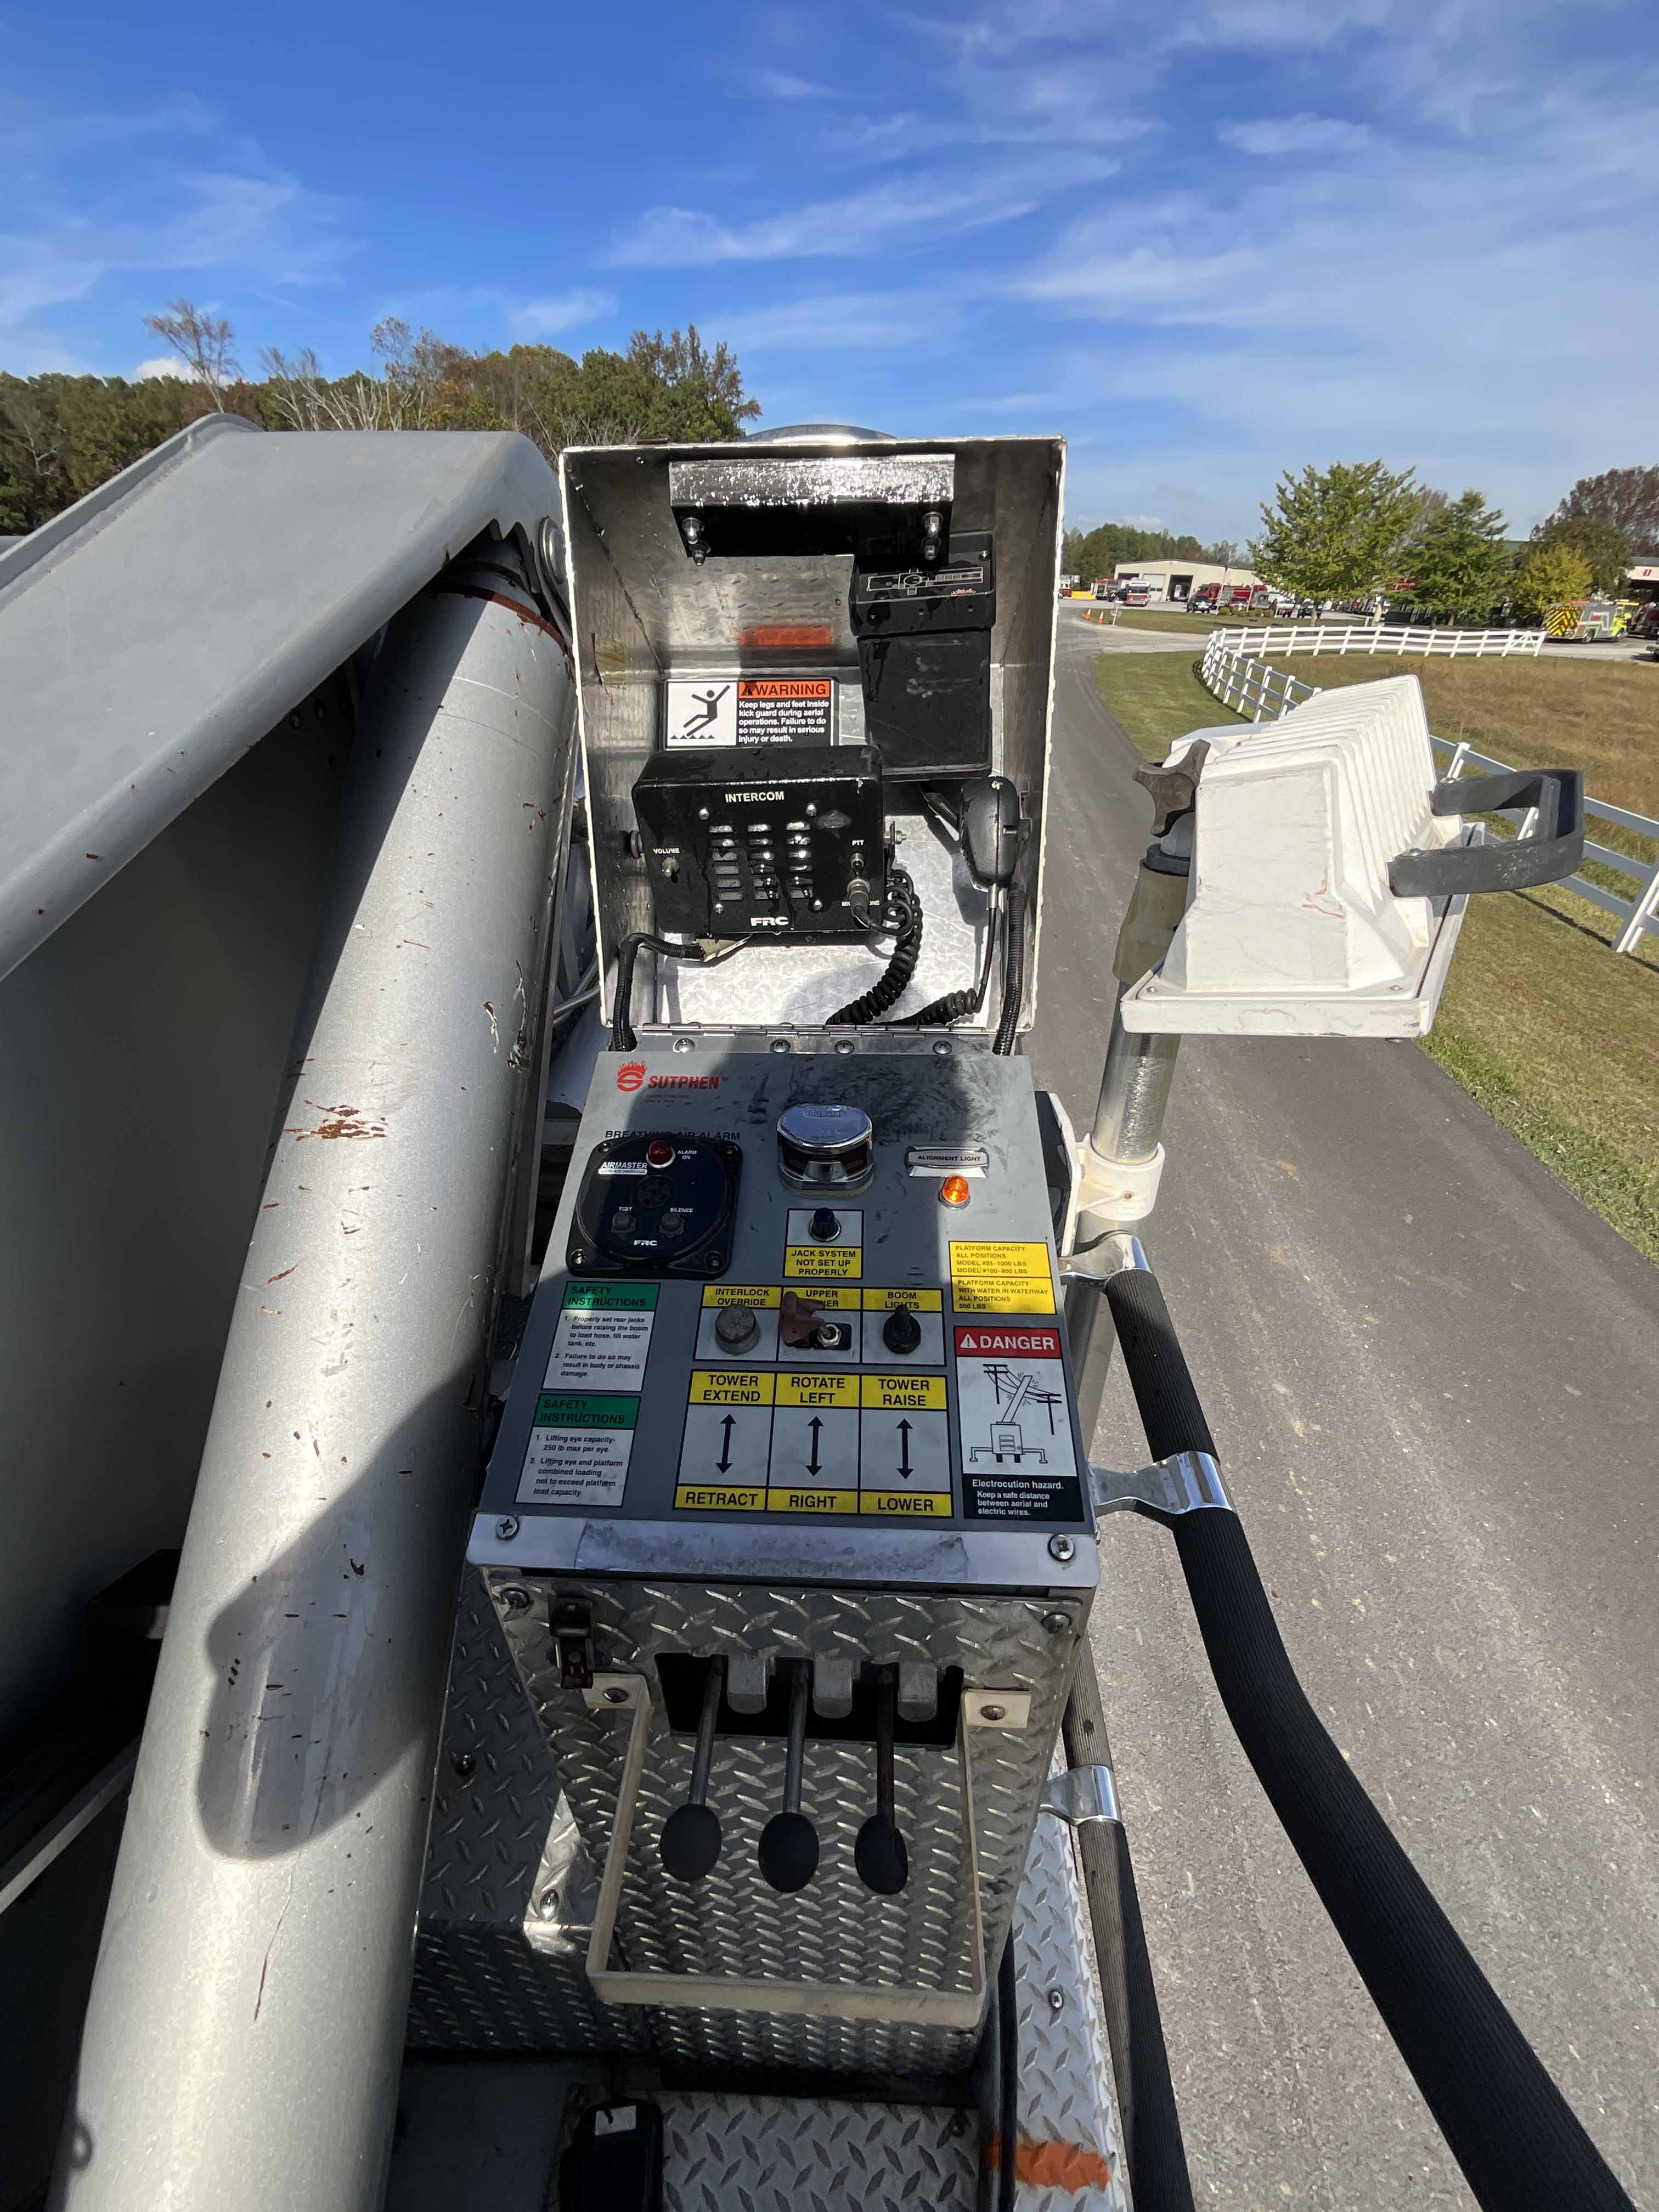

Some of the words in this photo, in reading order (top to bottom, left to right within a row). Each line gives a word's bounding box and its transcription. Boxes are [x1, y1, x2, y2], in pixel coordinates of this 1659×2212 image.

[755, 684, 826, 695] WARNING
[760, 701, 775, 709] legs
[755, 709, 776, 718] guard
[739, 718, 779, 726] operations.
[725, 791, 785, 803] INTERCOM
[751, 917, 789, 926] FRC
[648, 1076, 719, 1089] SUTPHEN
[698, 1132, 740, 1140] ALARM
[571, 1286, 611, 1294] SAFETY
[568, 1297, 646, 1306] INSTRUCTIONS
[980, 1335, 1054, 1350] DANGER
[709, 1375, 758, 1387] TOWER
[791, 1377, 845, 1389] ROTATE
[878, 1379, 929, 1391] TOWER
[704, 1390, 760, 1402] EXTEND
[800, 1392, 836, 1404] LEFT
[883, 1395, 926, 1406] RAISE
[544, 1400, 588, 1409] SAFETY
[540, 1413, 625, 1424] INSTRUCTIONS
[575, 1469, 601, 1477] loading
[972, 1480, 1030, 1488] Electrocution
[1032, 1481, 1064, 1489] hazard.
[551, 1488, 582, 1497] capacity.
[686, 1492, 758, 1506] RETRACT
[789, 1495, 837, 1509] RIGHT
[878, 1498, 933, 1511] LOWER
